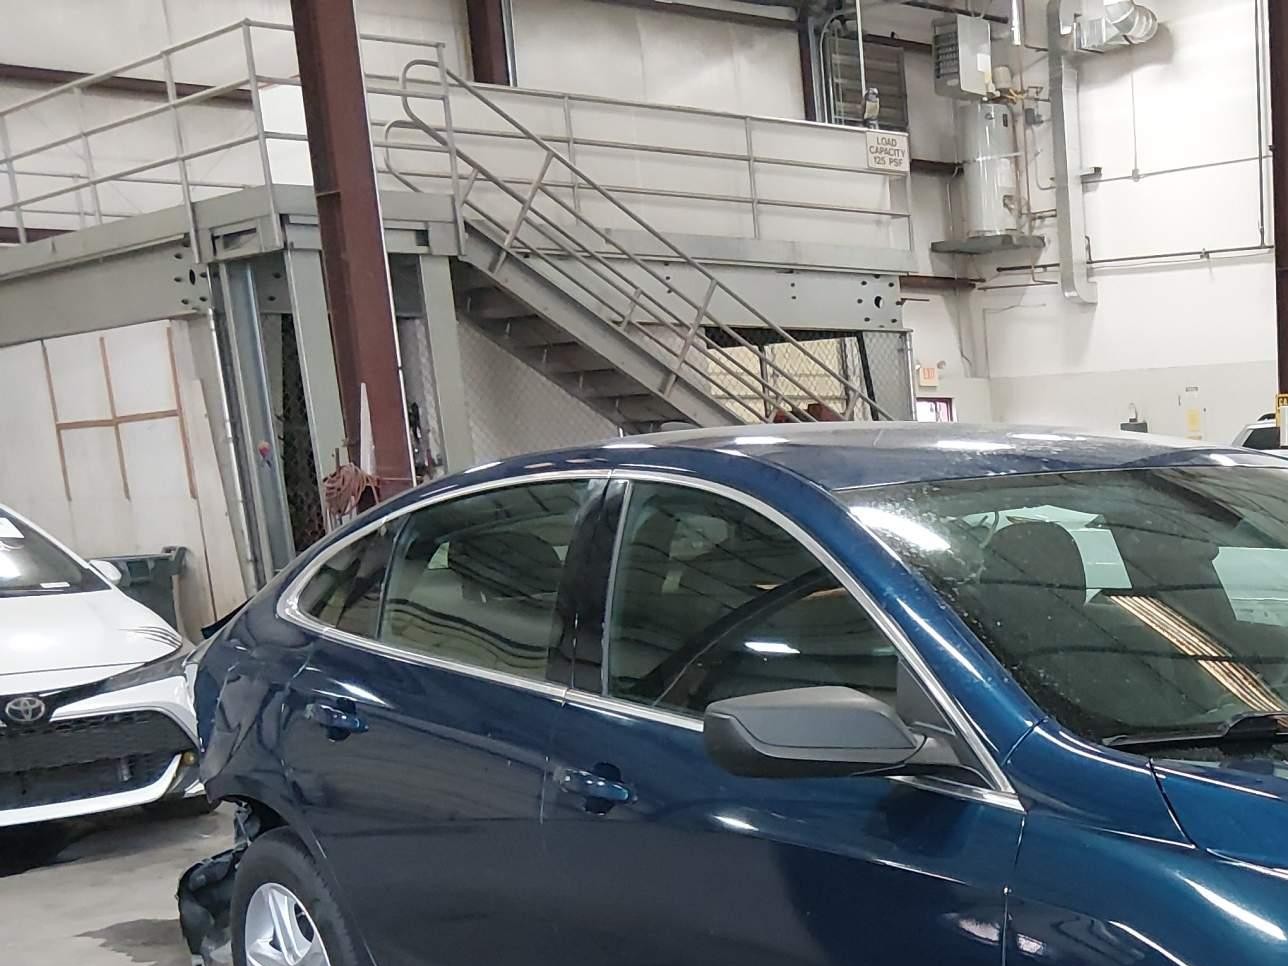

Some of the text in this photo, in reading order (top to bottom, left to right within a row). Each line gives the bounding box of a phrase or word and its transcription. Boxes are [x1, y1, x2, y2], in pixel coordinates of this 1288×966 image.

[876, 136, 898, 147] LOAD
[869, 145, 906, 158] CAPACITY
[874, 156, 903, 167] 125 PSF
